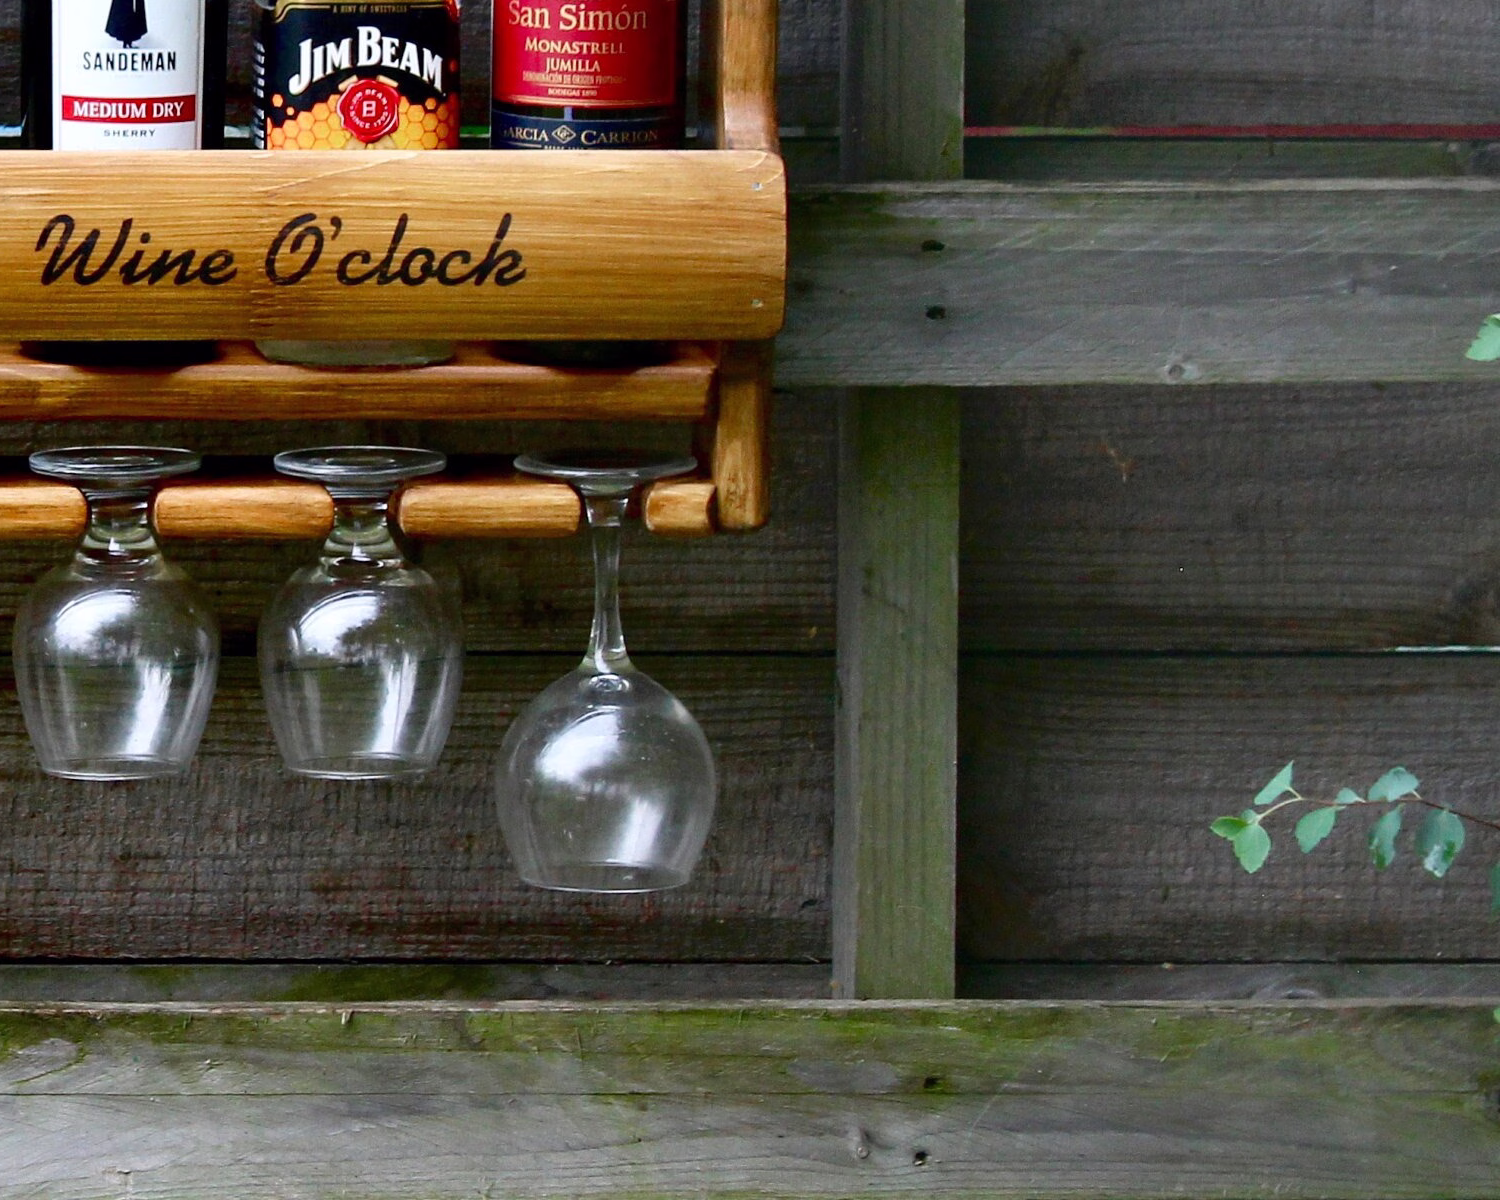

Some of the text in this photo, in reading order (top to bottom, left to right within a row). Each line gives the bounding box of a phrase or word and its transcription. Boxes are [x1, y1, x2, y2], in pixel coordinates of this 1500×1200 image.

[508, 0, 648, 32] San Simón
[524, 37, 626, 55] MONASTRELL
[83, 51, 177, 71] SANDEMAN
[288, 37, 353, 96] JIM
[356, 25, 443, 93] BEAM
[545, 57, 601, 73] JUMILLA
[365, 88, 388, 106] BEAM
[73, 100, 184, 119] MEDIUM DRY
[103, 129, 156, 137] SHERRY
[34, 213, 239, 286] Wine
[264, 211, 527, 287] O'clock
